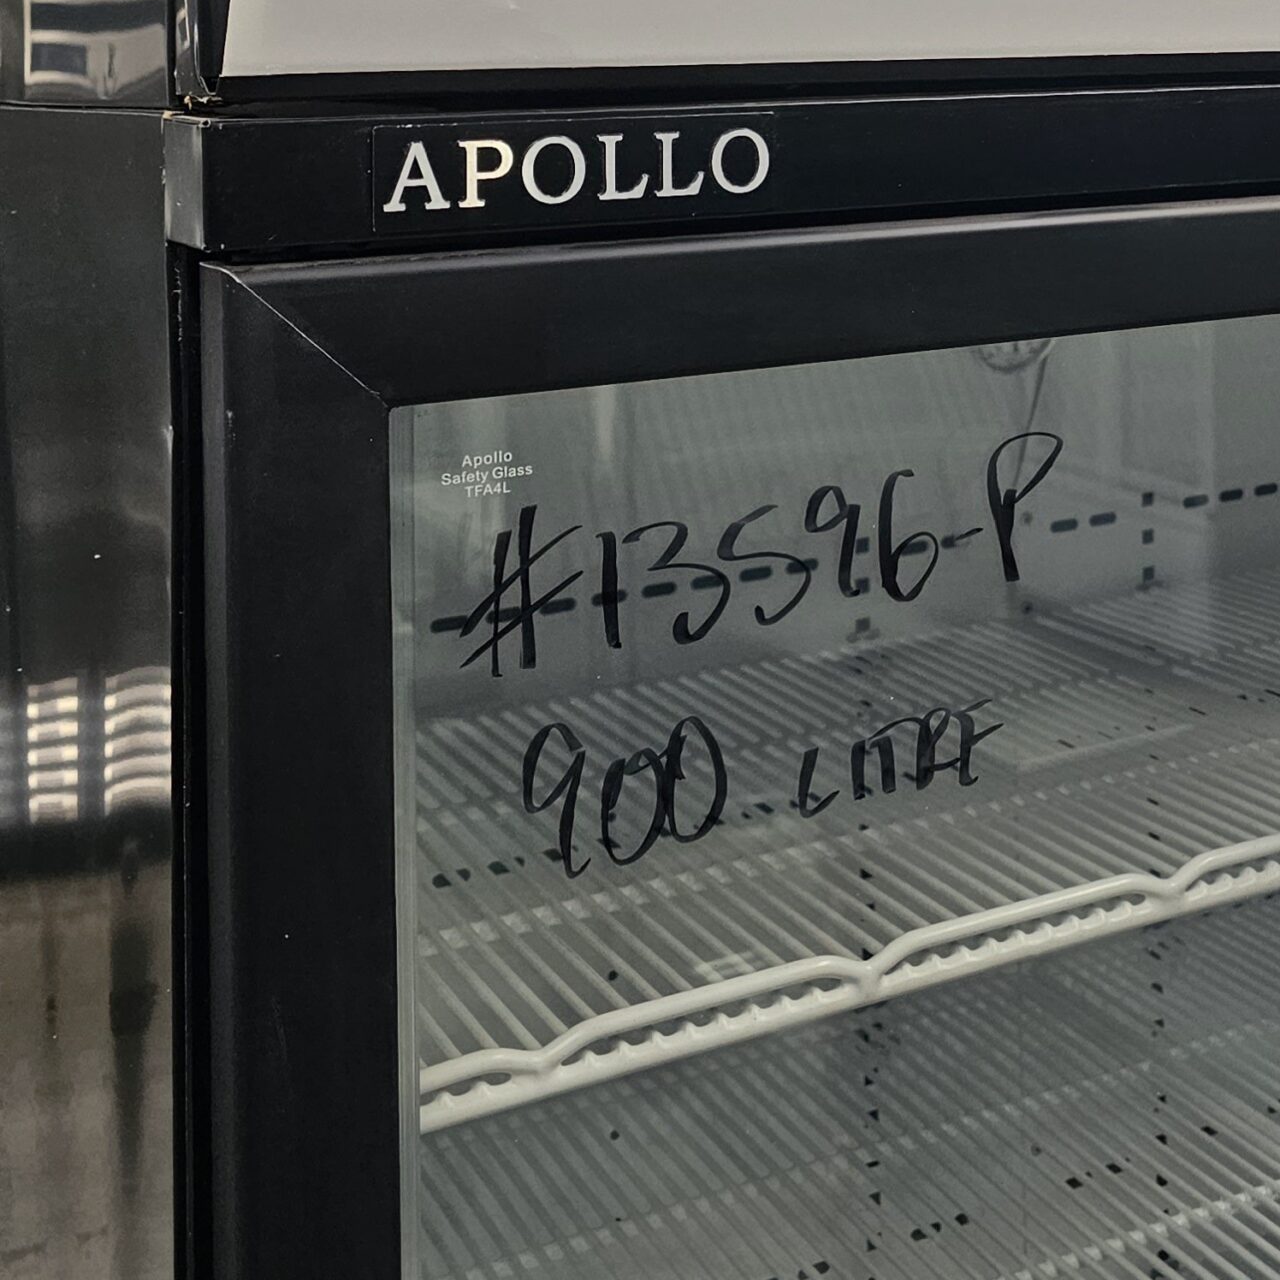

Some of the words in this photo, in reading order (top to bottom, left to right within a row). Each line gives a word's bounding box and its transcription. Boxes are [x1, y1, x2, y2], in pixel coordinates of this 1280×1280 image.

[383, 127, 770, 213] APOLLO
[441, 470, 489, 486] Safety
[492, 465, 533, 479] Glass
[462, 450, 513, 469] Apollo
[465, 481, 512, 498] TFA4L
[459, 431, 1064, 678] #13596-P
[522, 716, 728, 879] 900
